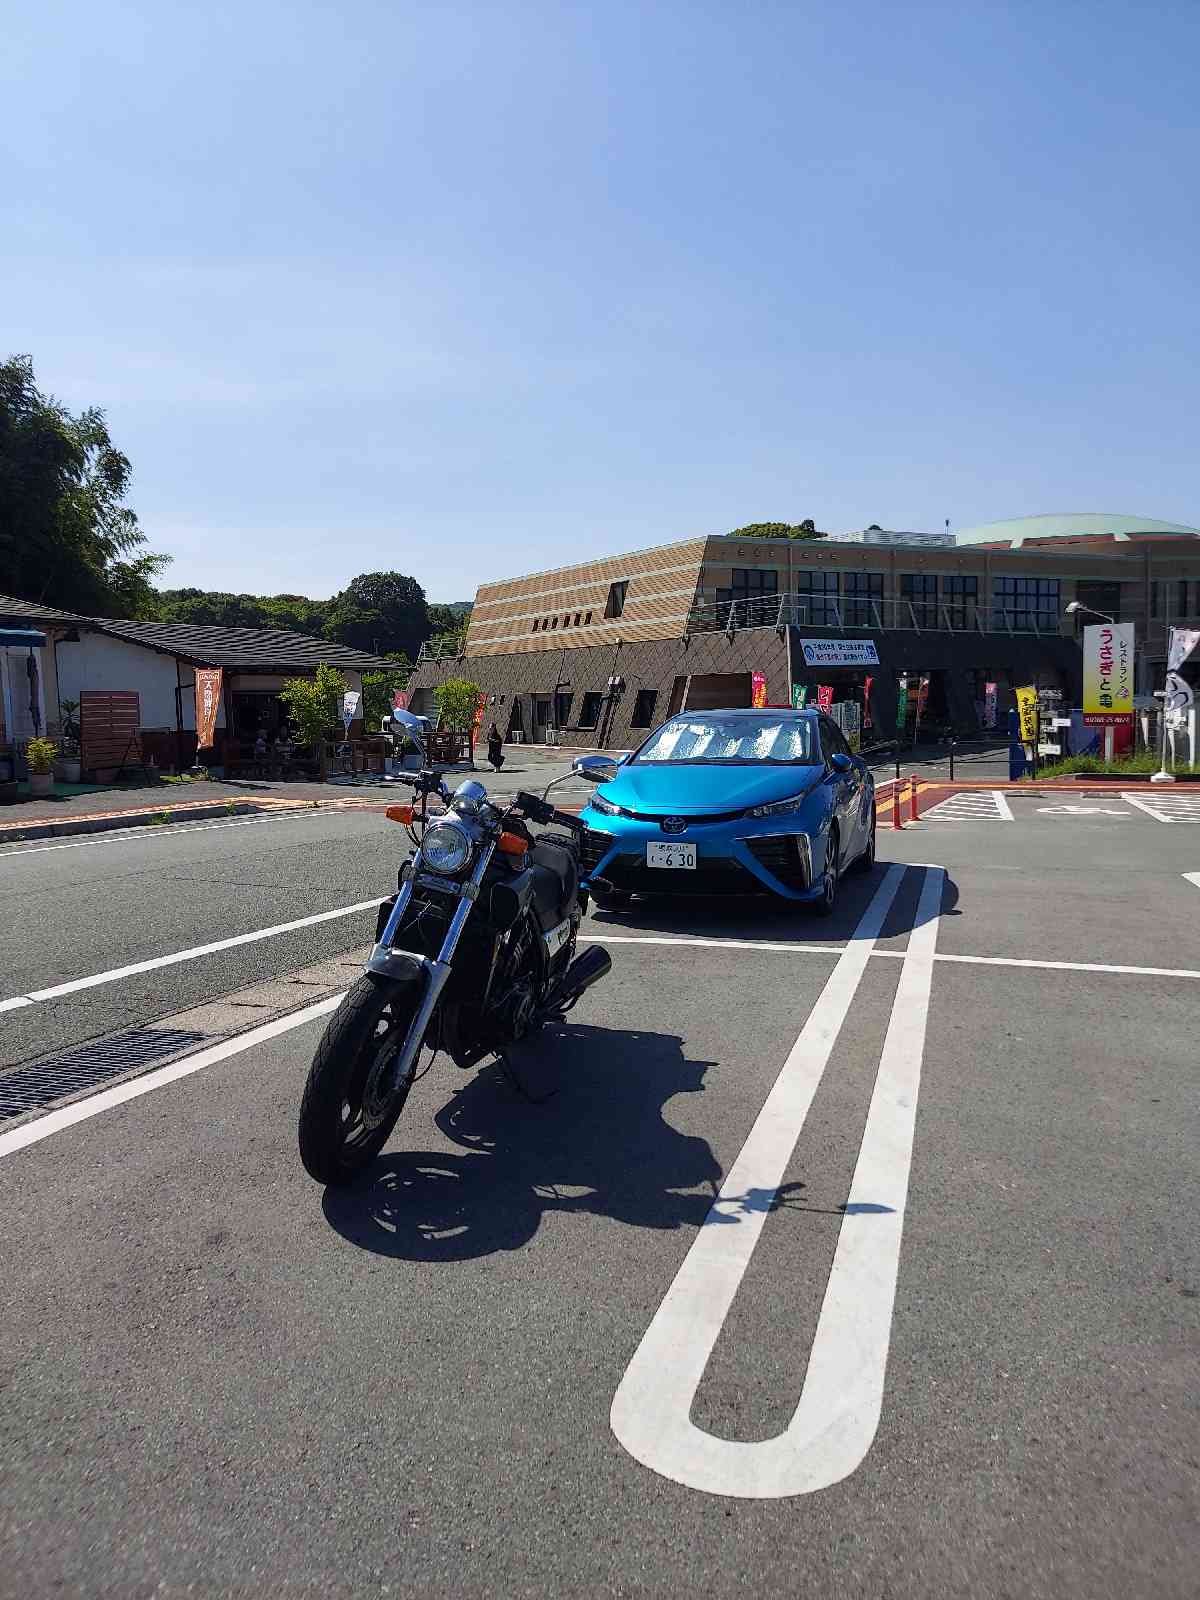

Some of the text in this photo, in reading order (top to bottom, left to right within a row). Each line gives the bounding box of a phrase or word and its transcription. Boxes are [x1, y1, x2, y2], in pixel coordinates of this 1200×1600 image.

[1099, 629, 1113, 709] うさぎと亀
